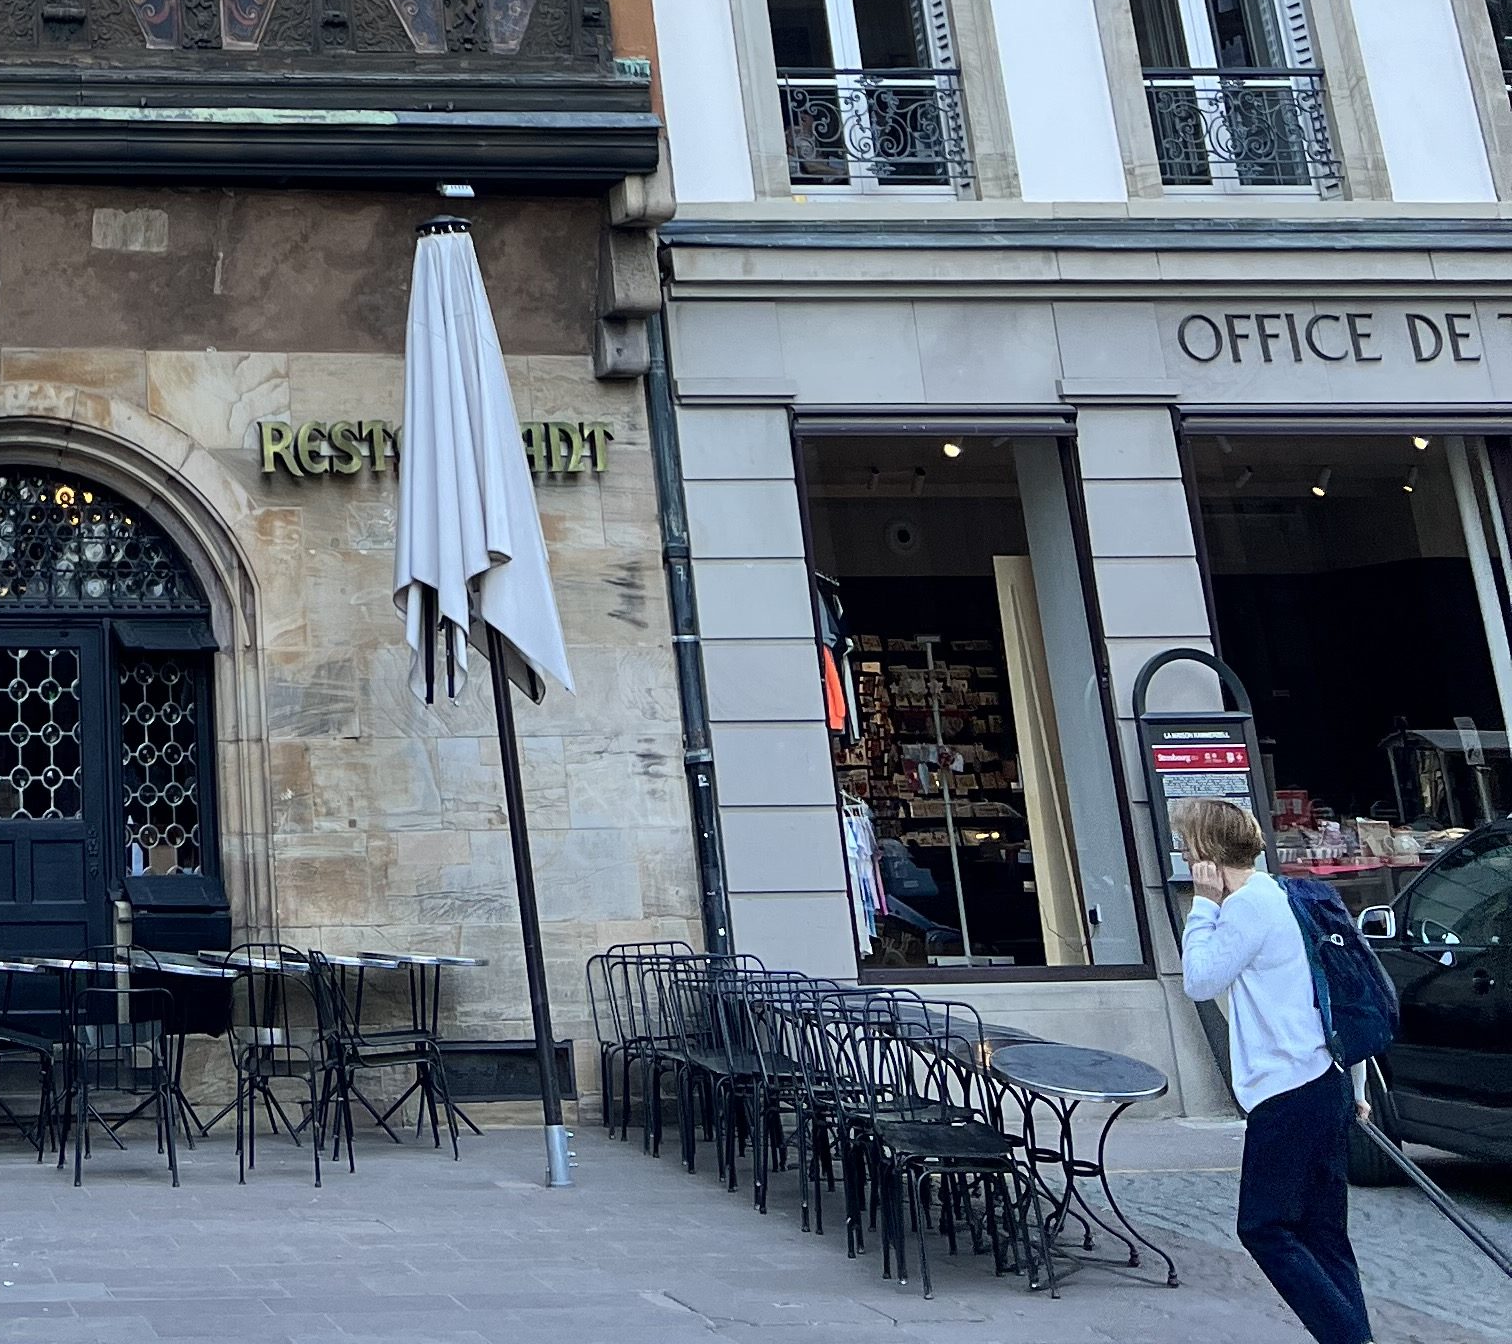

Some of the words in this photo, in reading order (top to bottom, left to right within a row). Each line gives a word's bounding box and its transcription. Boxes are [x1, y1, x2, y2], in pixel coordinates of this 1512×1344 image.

[1177, 312, 1383, 363] OFFICE
[1405, 312, 1481, 363] DE
[258, 420, 615, 477] RESTANT
